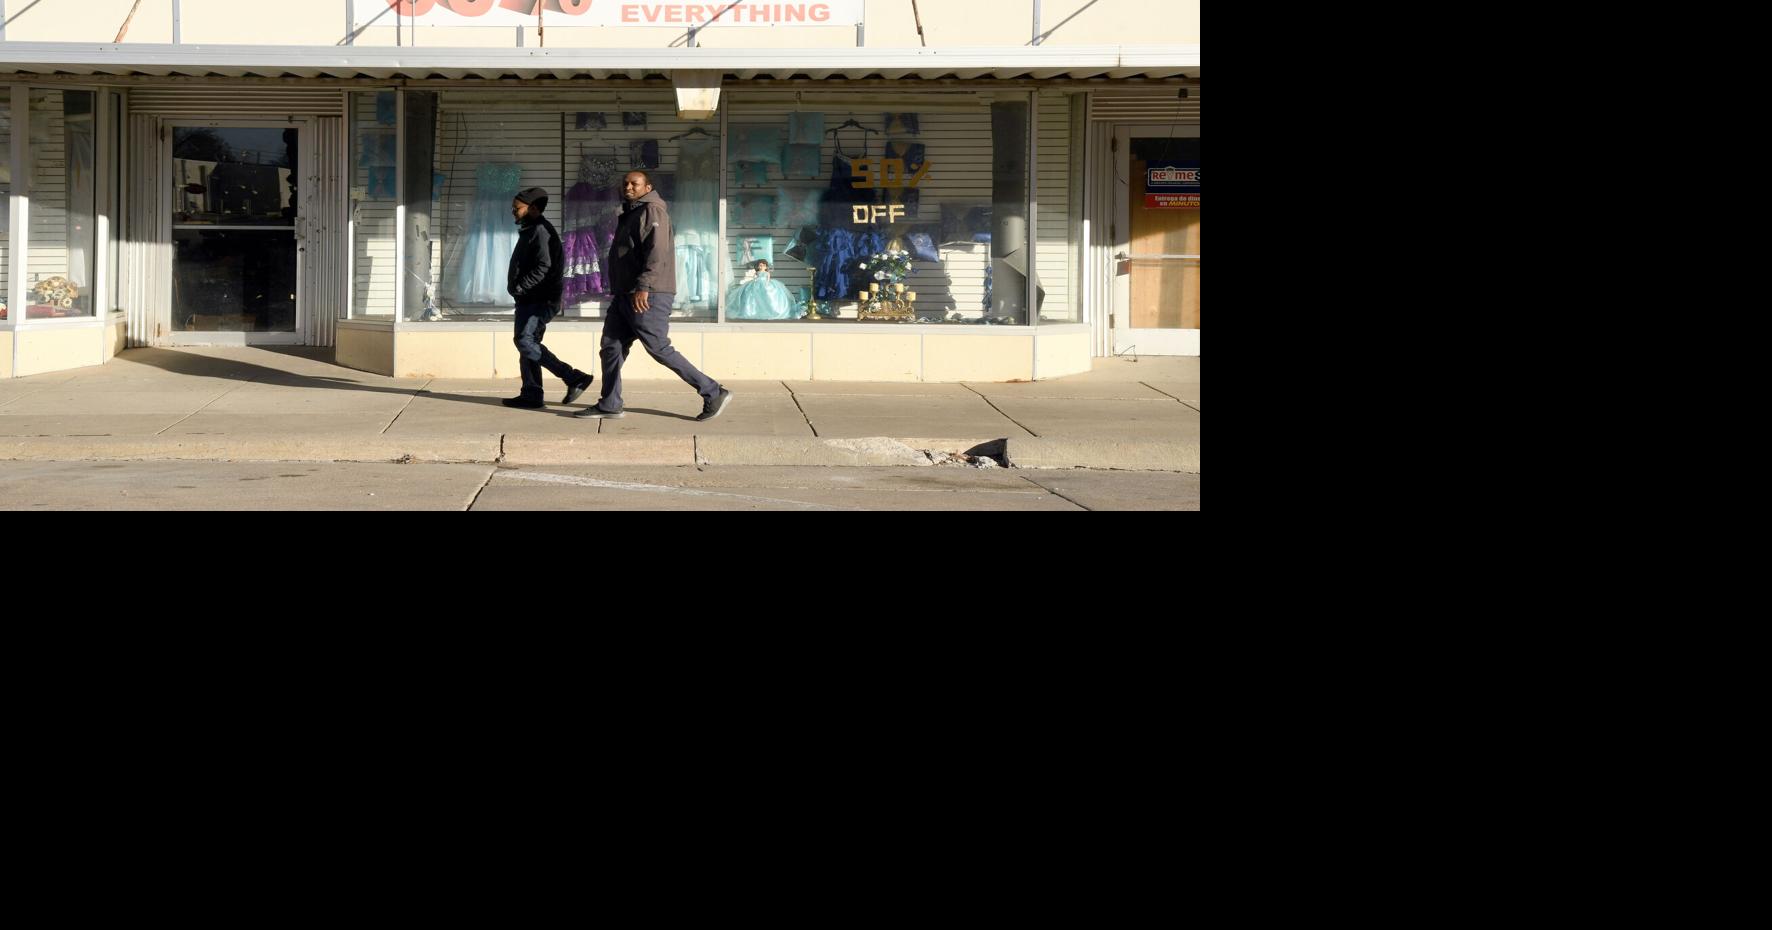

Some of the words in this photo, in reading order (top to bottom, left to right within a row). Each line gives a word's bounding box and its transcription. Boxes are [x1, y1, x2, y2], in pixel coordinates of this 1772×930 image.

[621, 4, 831, 23] EVERYTHING
[851, 158, 932, 188] 50%
[852, 204, 905, 224] OFF
